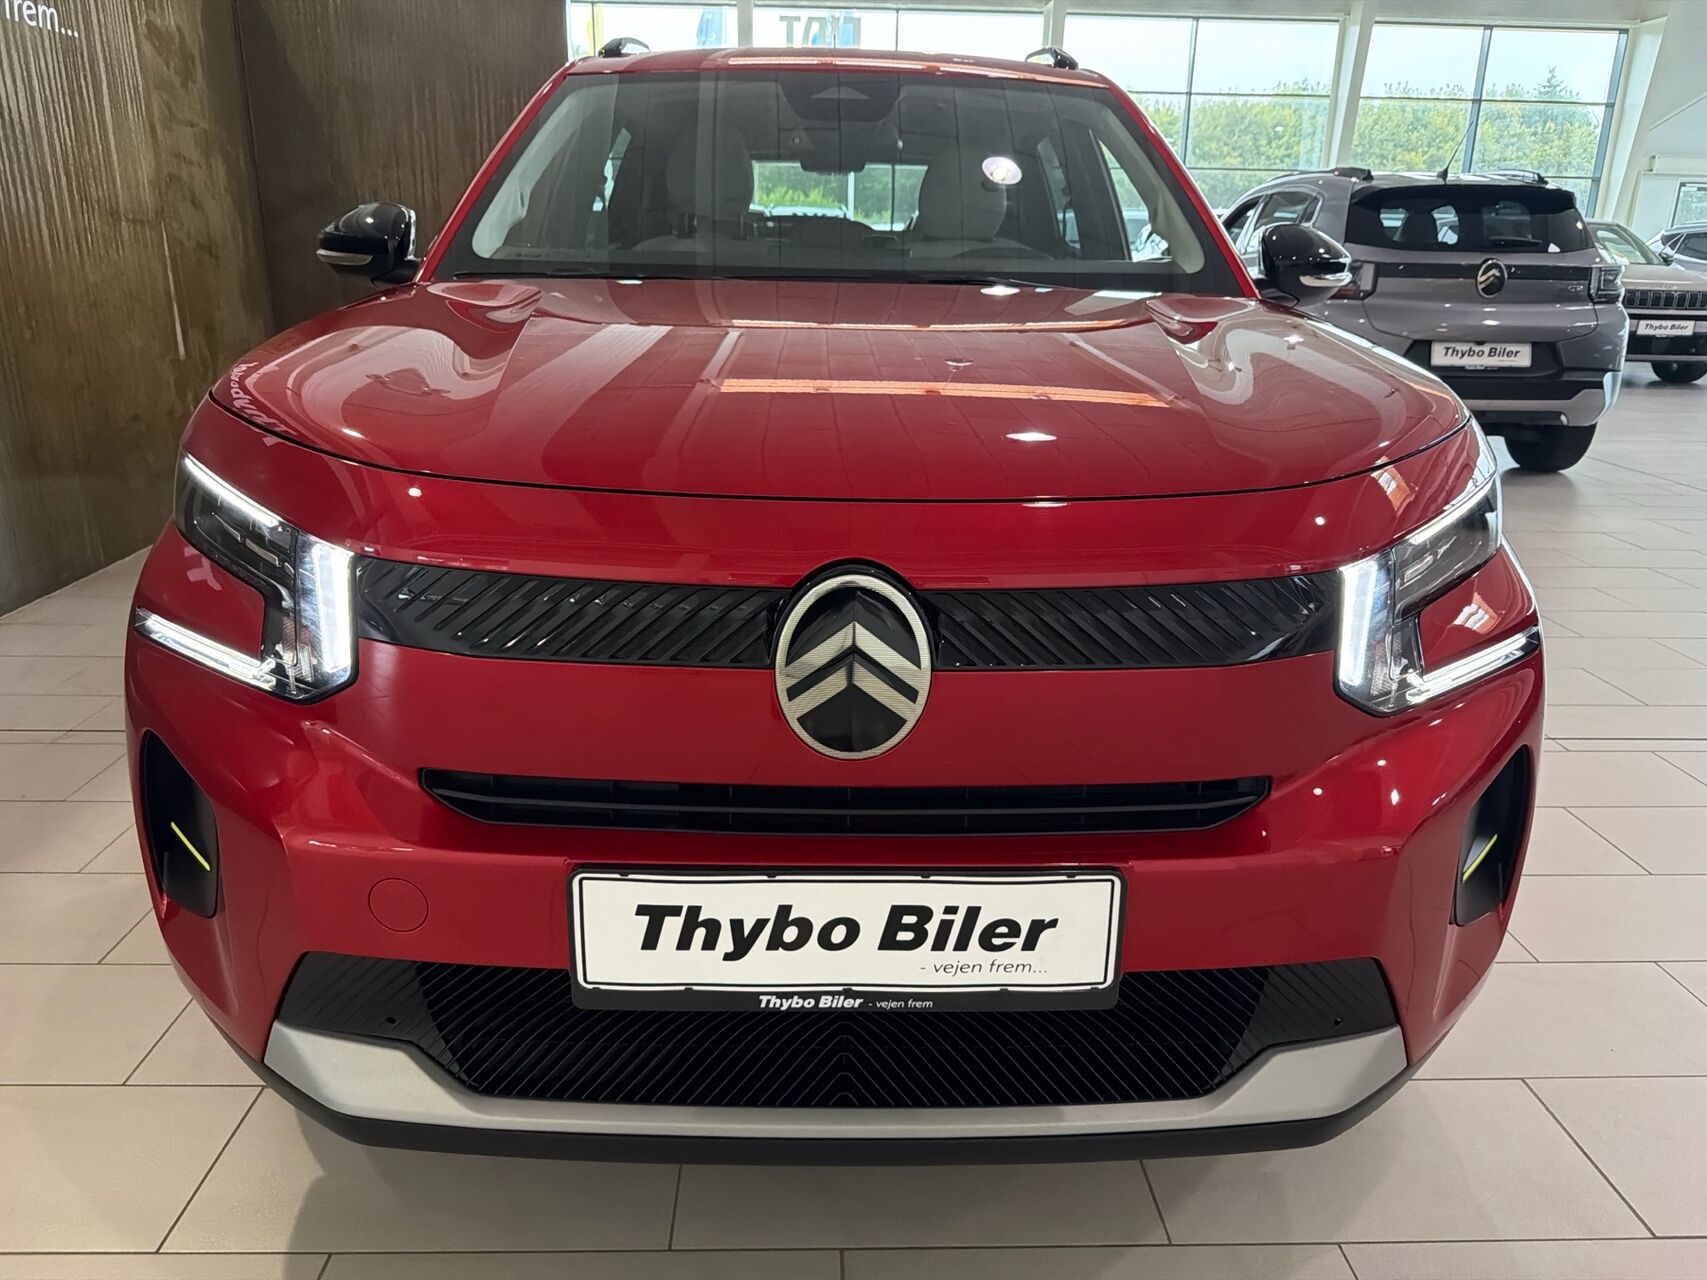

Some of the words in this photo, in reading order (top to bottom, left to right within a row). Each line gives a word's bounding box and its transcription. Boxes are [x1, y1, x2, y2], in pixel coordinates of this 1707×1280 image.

[1443, 346, 1485, 359] Thybo
[1487, 347, 1521, 358] Biler
[634, 903, 861, 962] Thybo
[877, 904, 1060, 953] Biler
[933, 960, 983, 977] vejen
[989, 959, 1048, 974] frem...
[759, 995, 815, 1010] Thybo
[818, 995, 864, 1009] Biler
[875, 999, 905, 1010] vejen
[907, 999, 933, 1008] frem
